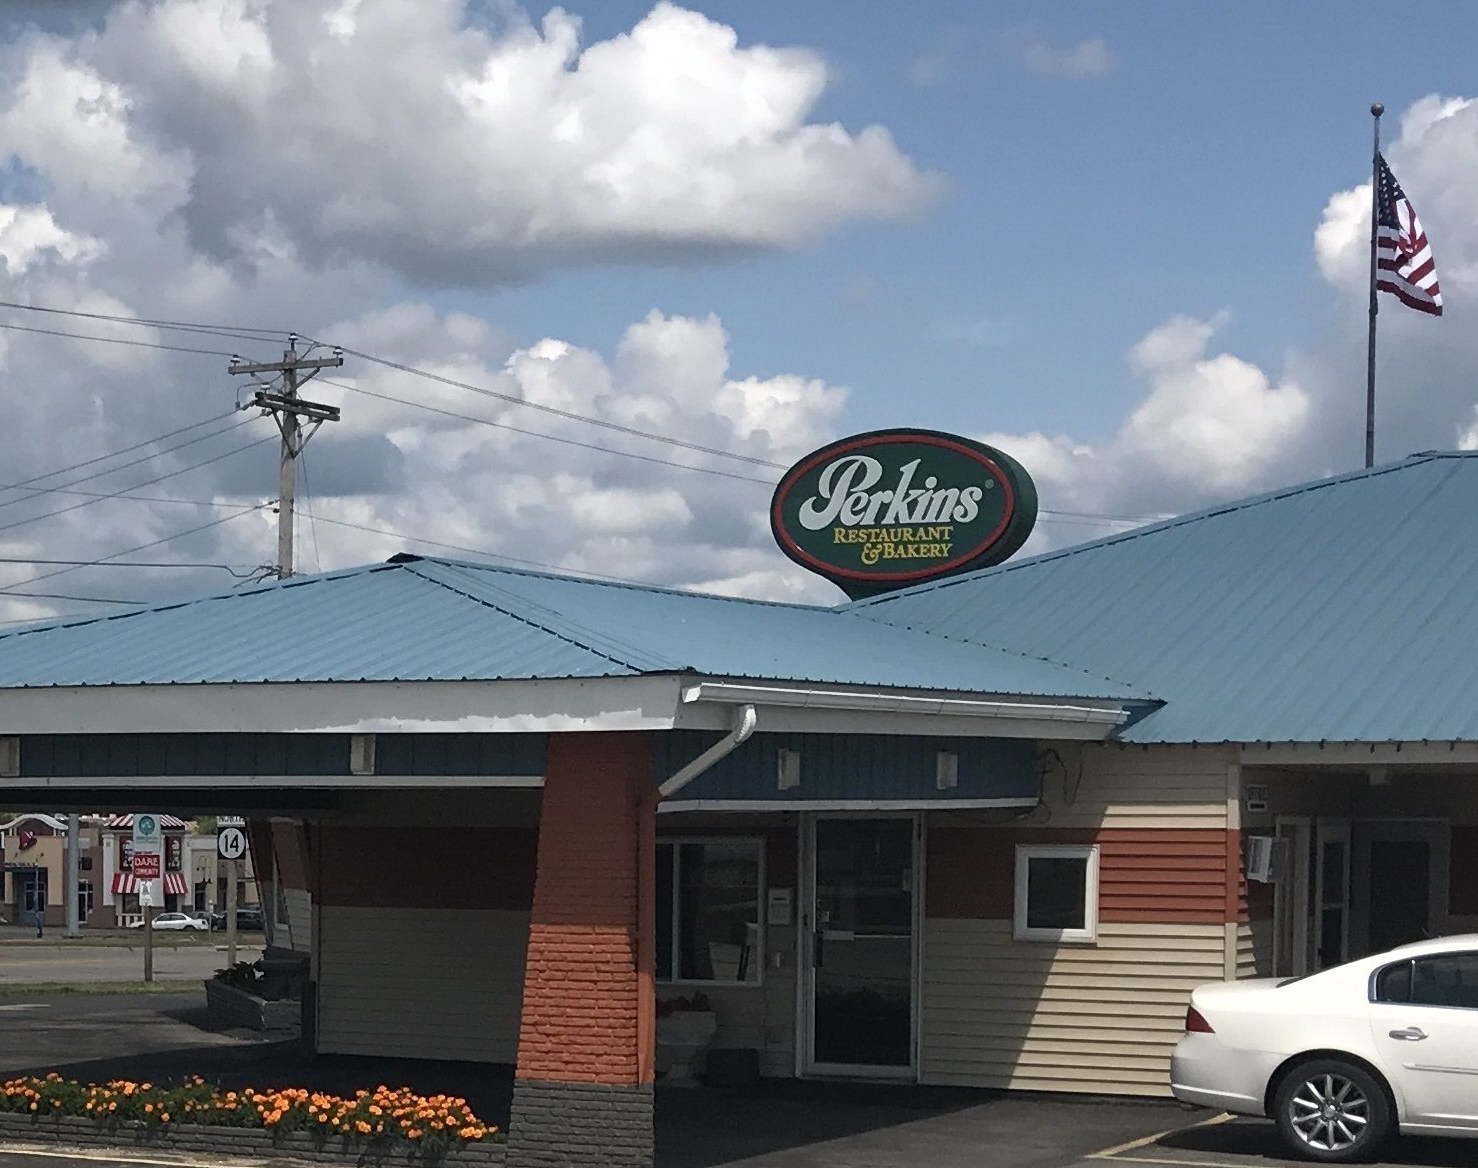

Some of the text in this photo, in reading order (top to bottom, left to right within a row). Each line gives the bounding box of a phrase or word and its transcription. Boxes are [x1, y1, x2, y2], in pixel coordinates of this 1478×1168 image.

[799, 455, 983, 530] Perkins
[833, 526, 954, 544] RESTAURANT
[224, 834, 239, 852] 14
